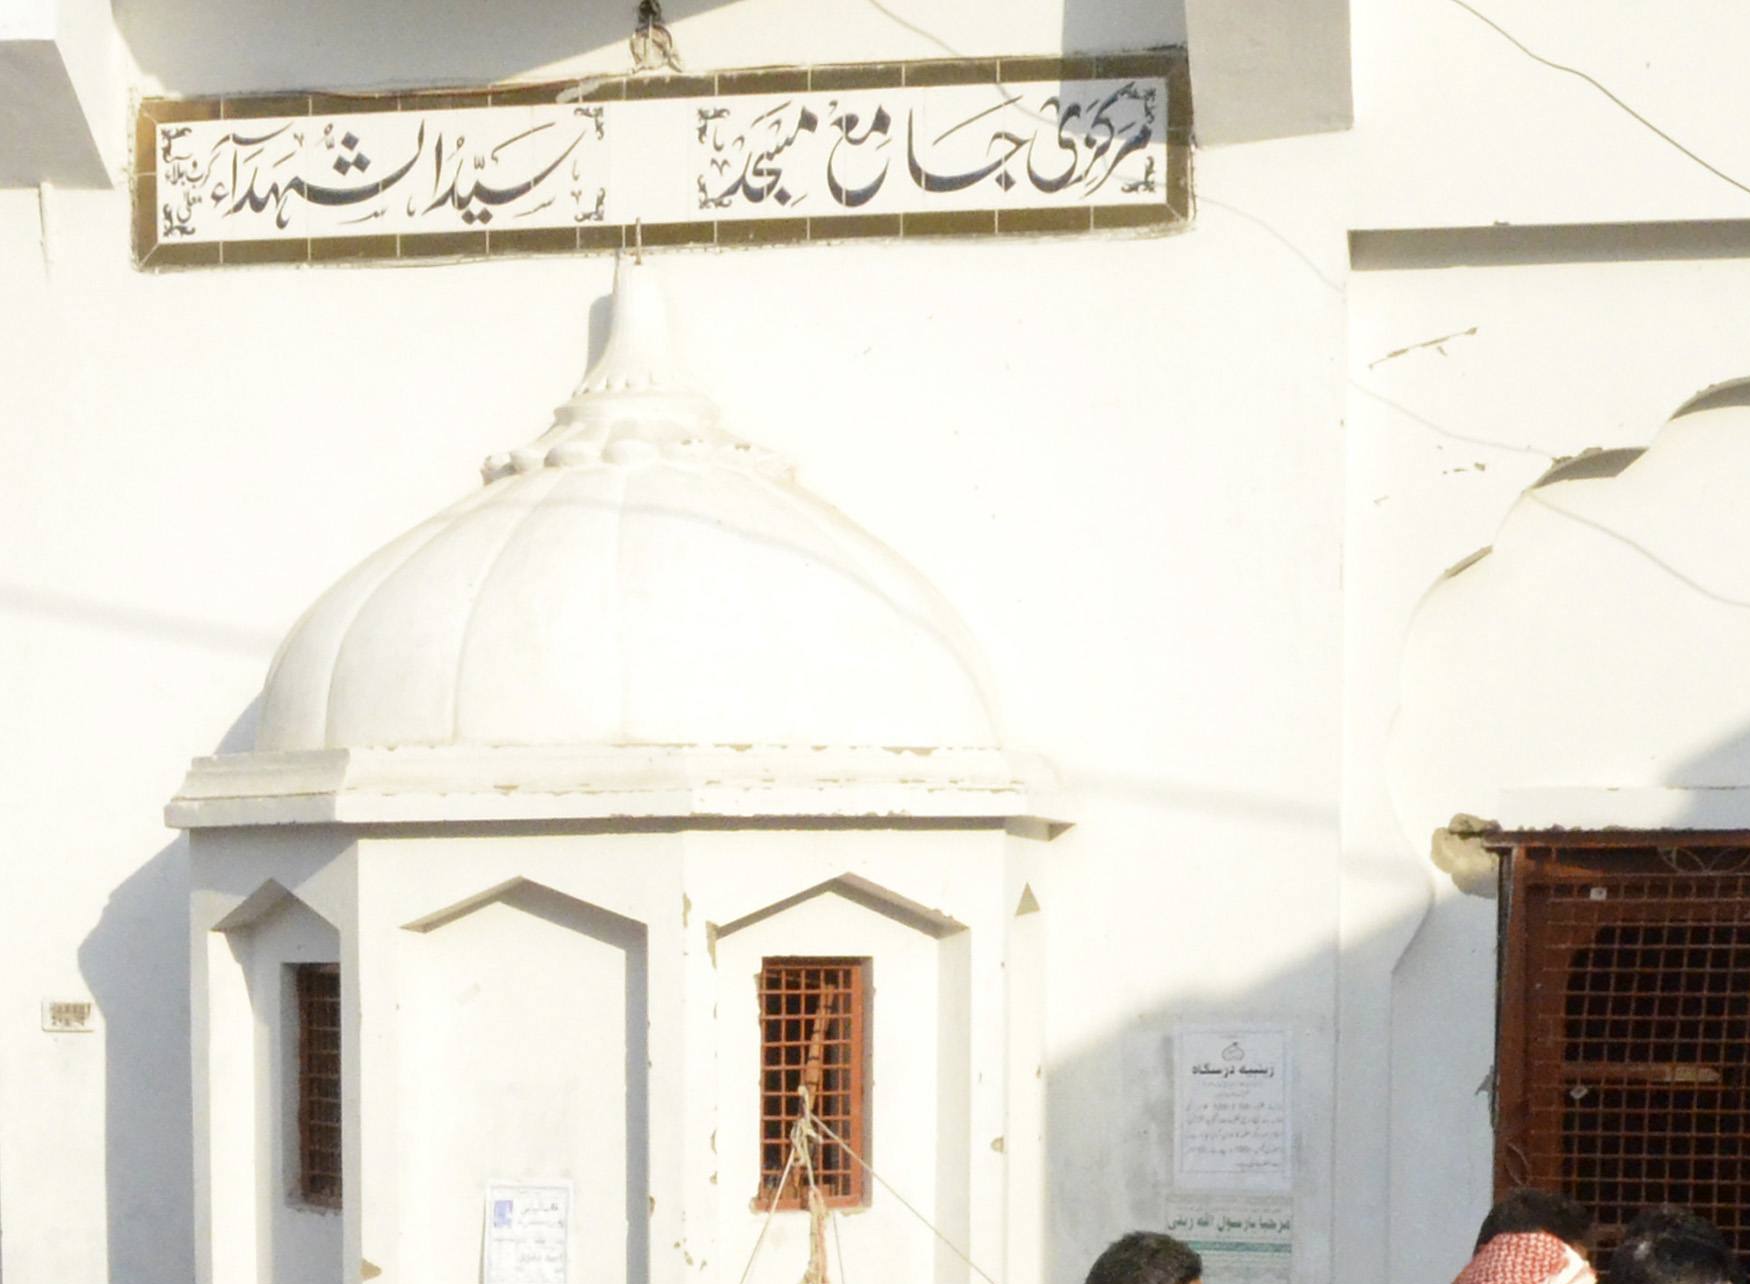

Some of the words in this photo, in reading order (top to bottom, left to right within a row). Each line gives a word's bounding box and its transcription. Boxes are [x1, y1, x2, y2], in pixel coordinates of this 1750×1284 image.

[714, 100, 818, 208] مسجد
[827, 94, 1032, 208] جامع
[1027, 82, 1152, 199] مرکزی
